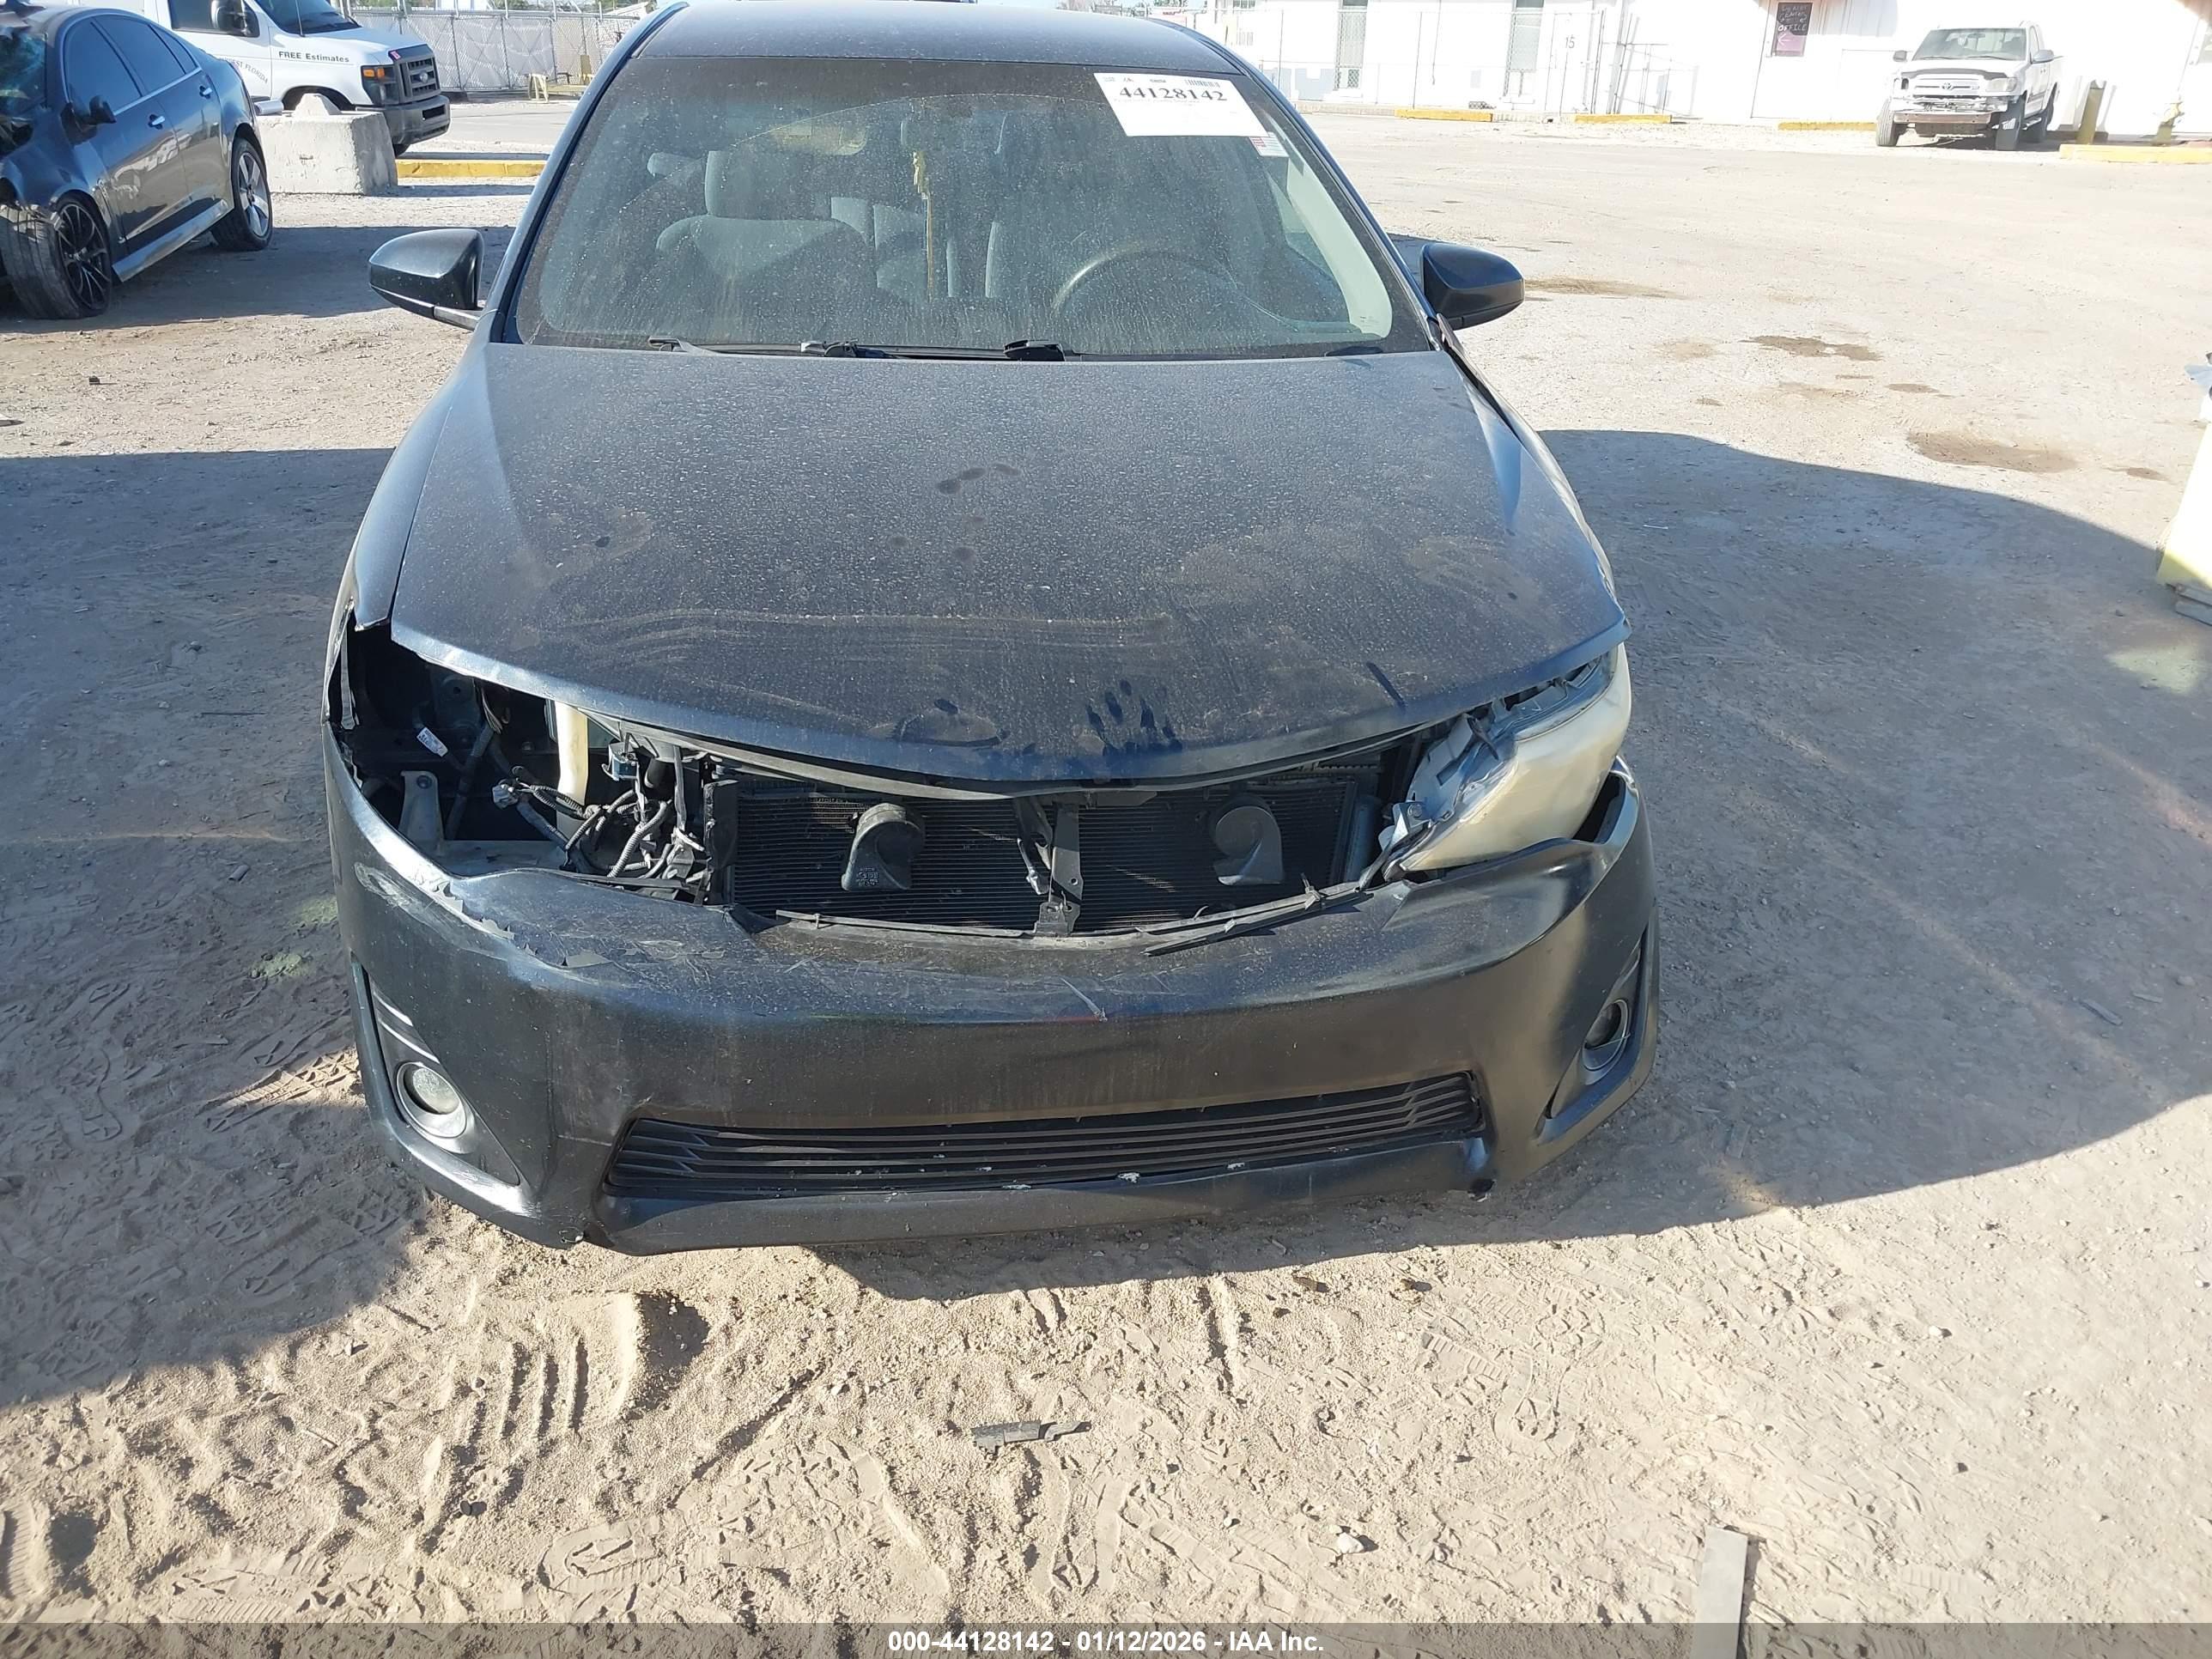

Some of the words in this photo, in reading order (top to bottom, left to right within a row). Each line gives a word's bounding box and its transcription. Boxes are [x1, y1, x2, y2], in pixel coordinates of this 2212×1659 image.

[278, 51, 301, 59] FREE
[305, 52, 349, 63] Estimates
[1119, 87, 1227, 101] 44128142
